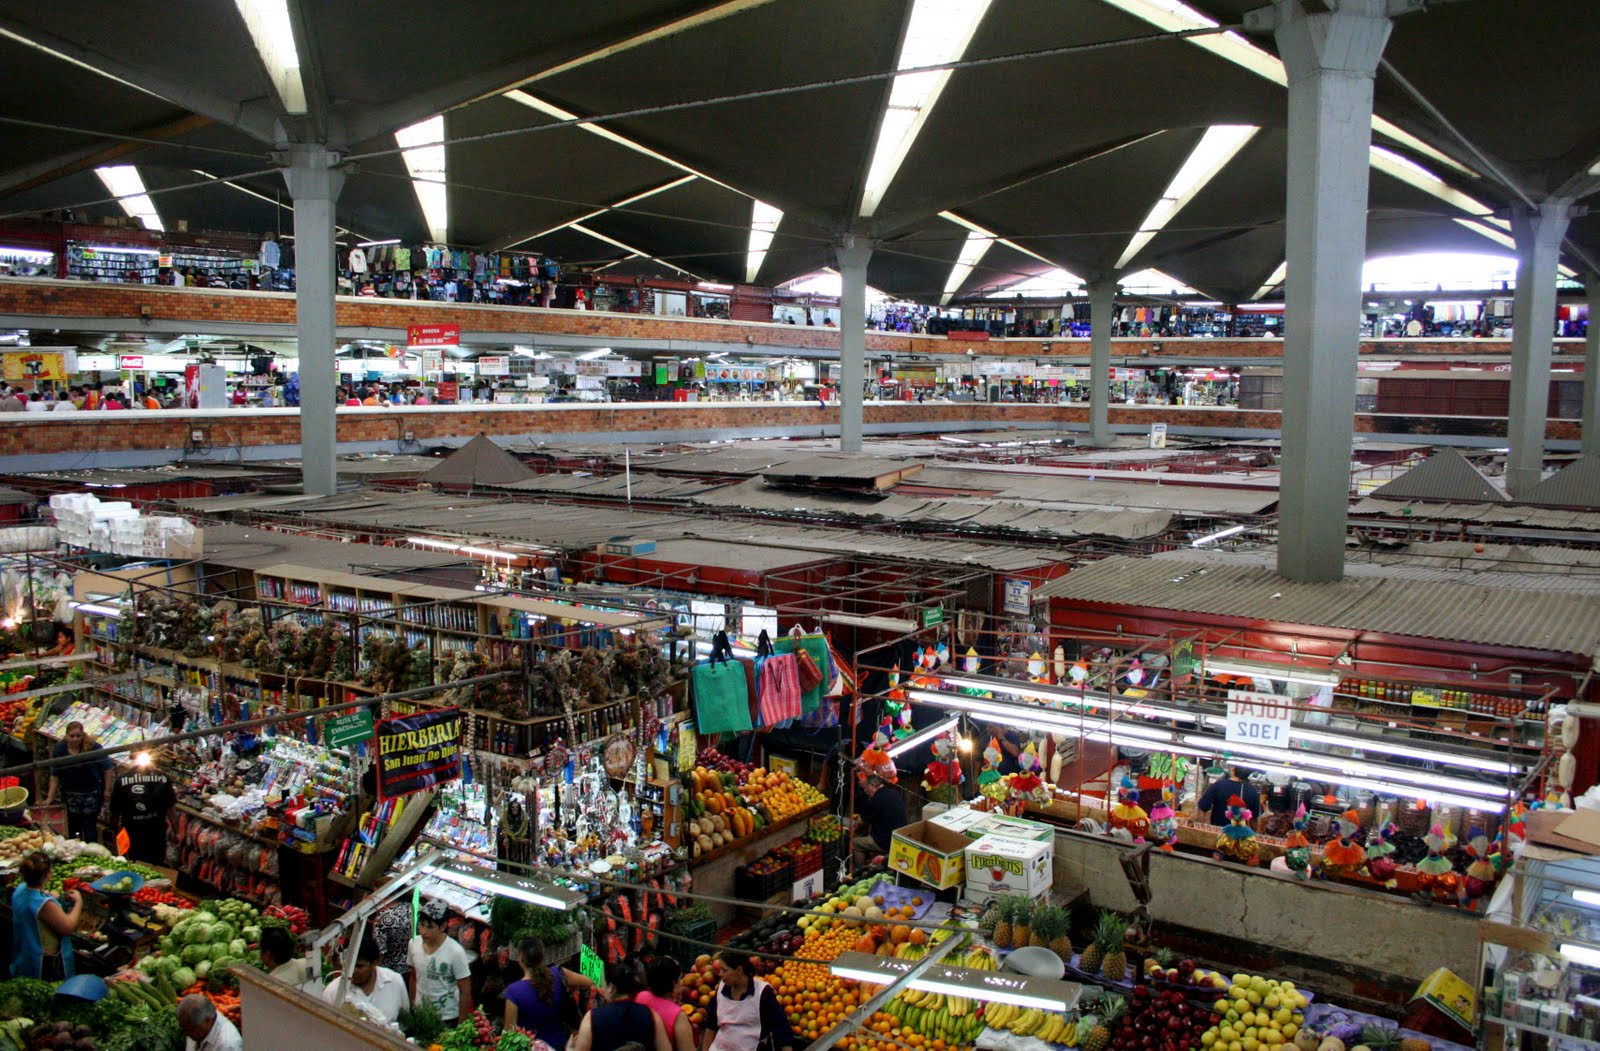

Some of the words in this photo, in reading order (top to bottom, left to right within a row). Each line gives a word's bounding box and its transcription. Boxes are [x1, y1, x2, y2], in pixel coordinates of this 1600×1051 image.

[384, 757, 401, 771] San
[402, 752, 425, 767] Juan
[427, 749, 440, 762] De
[441, 744, 458, 759] Dios
